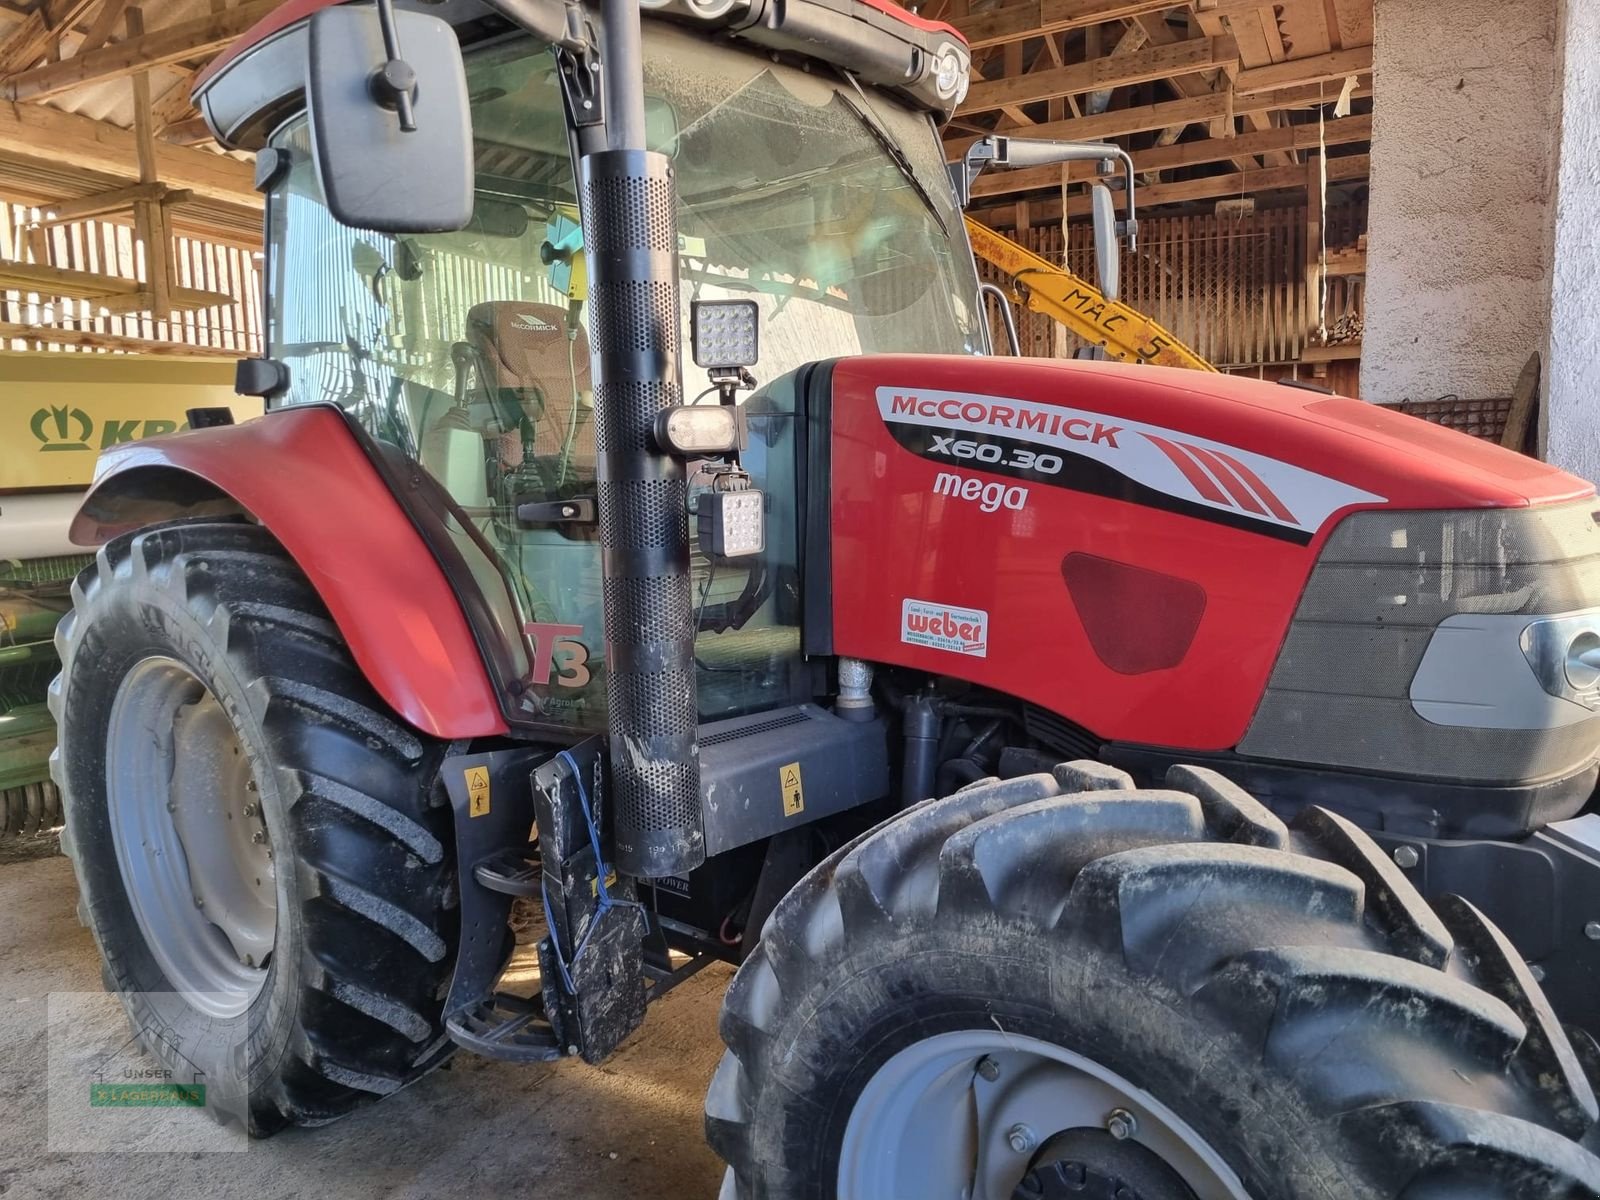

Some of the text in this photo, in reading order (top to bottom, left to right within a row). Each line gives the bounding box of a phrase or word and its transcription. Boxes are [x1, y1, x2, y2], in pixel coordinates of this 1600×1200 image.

[1137, 335, 1172, 359] 5
[891, 395, 1125, 449] McCORMICK
[927, 434, 1063, 475] X60.30
[933, 472, 1029, 513] mega
[907, 611, 982, 642] weber
[524, 622, 592, 689] T3
